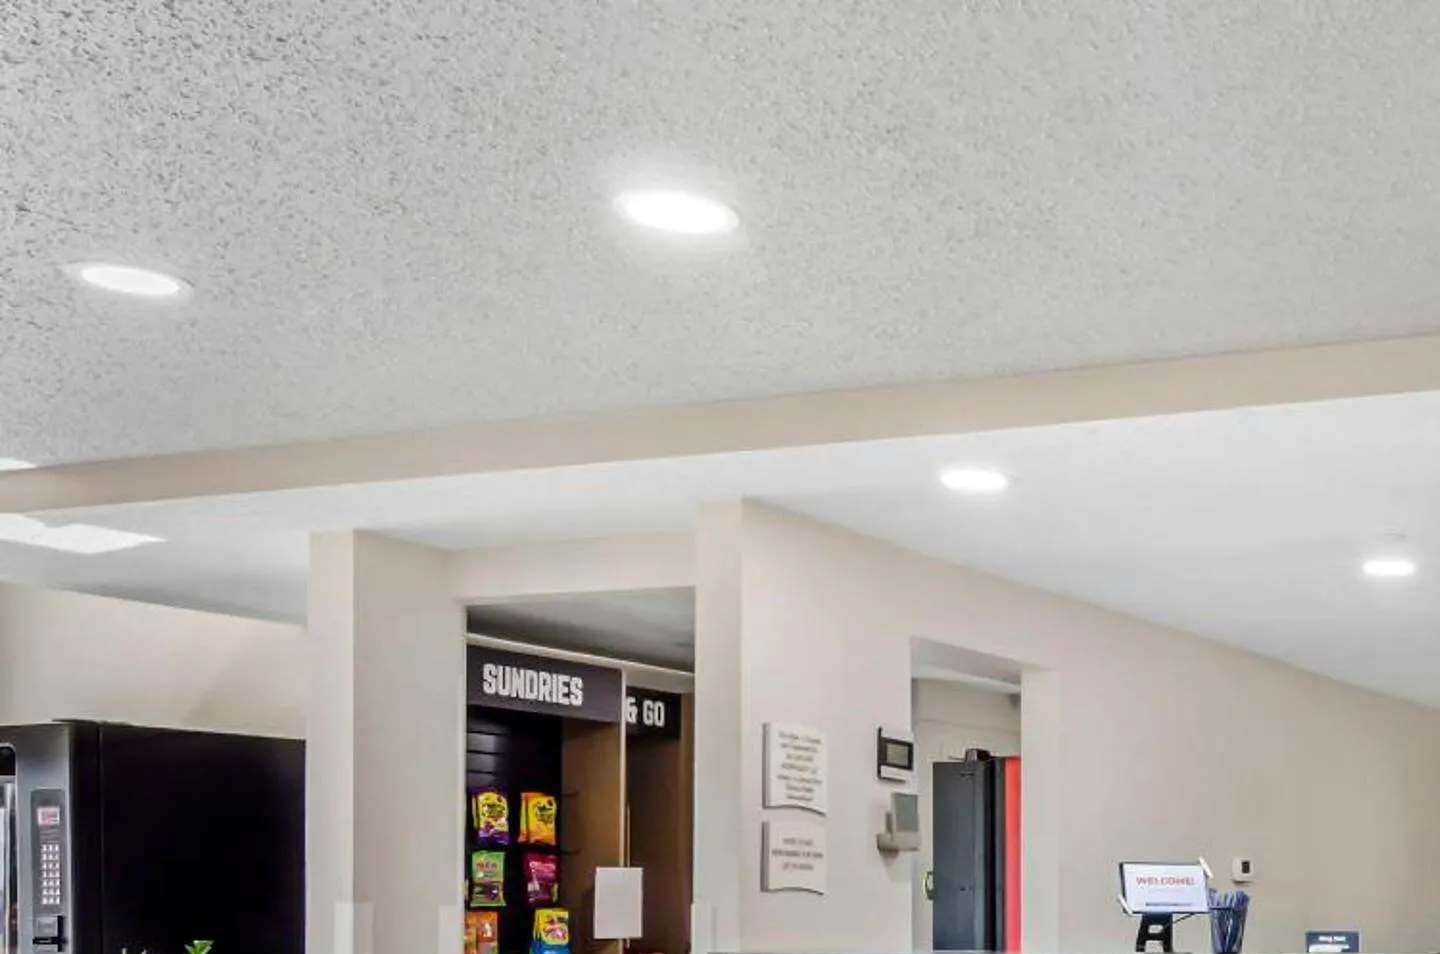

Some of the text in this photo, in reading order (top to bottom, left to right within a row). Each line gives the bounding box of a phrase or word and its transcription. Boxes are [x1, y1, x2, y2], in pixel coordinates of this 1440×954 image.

[483, 663, 583, 706] SUNDRIES
[626, 696, 665, 727] & GO
